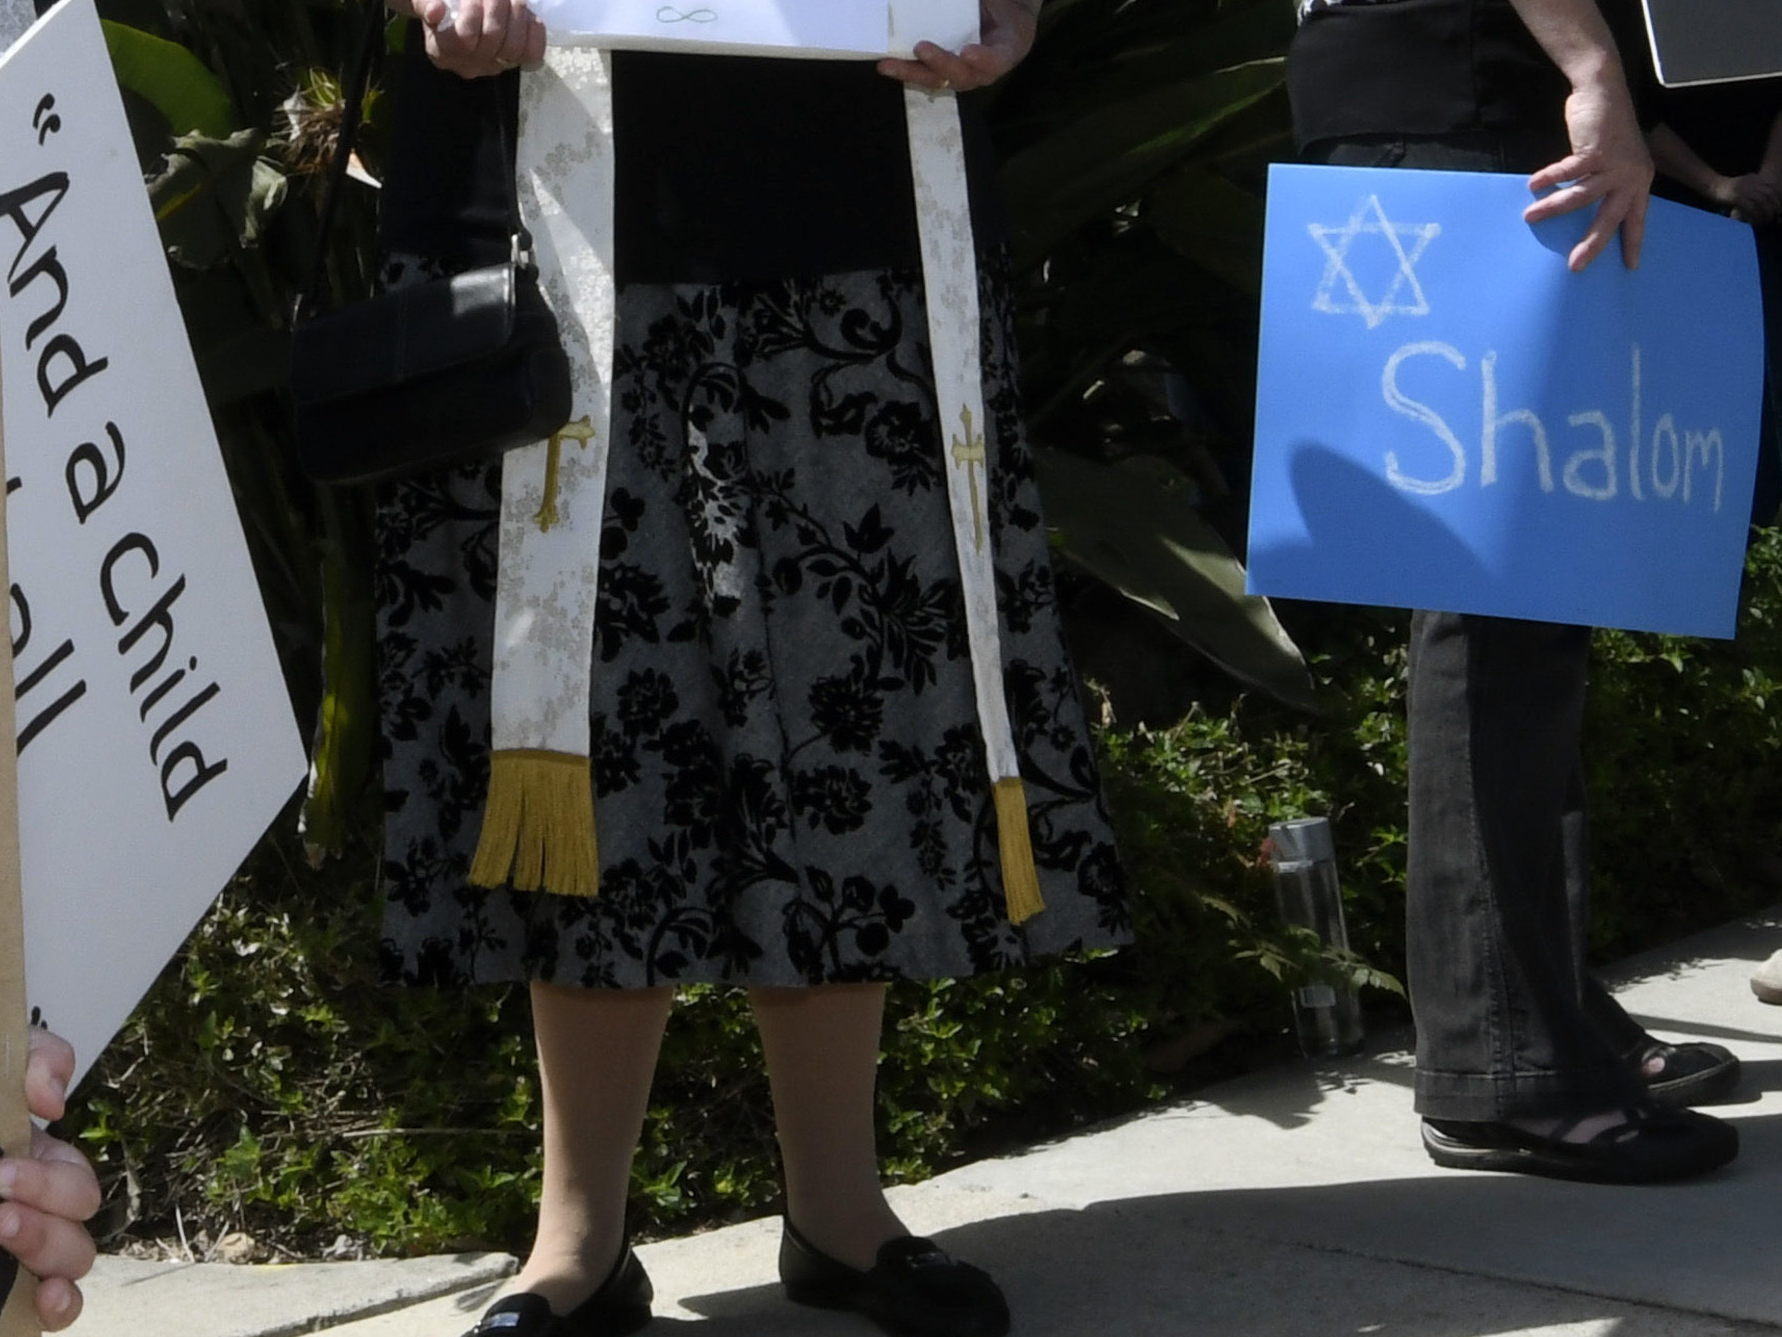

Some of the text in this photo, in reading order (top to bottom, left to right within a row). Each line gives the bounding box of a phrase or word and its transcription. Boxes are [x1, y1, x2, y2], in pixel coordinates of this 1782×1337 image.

[1382, 340, 1724, 513] Shalom
[64, 421, 126, 524] a
[98, 532, 229, 822] child
